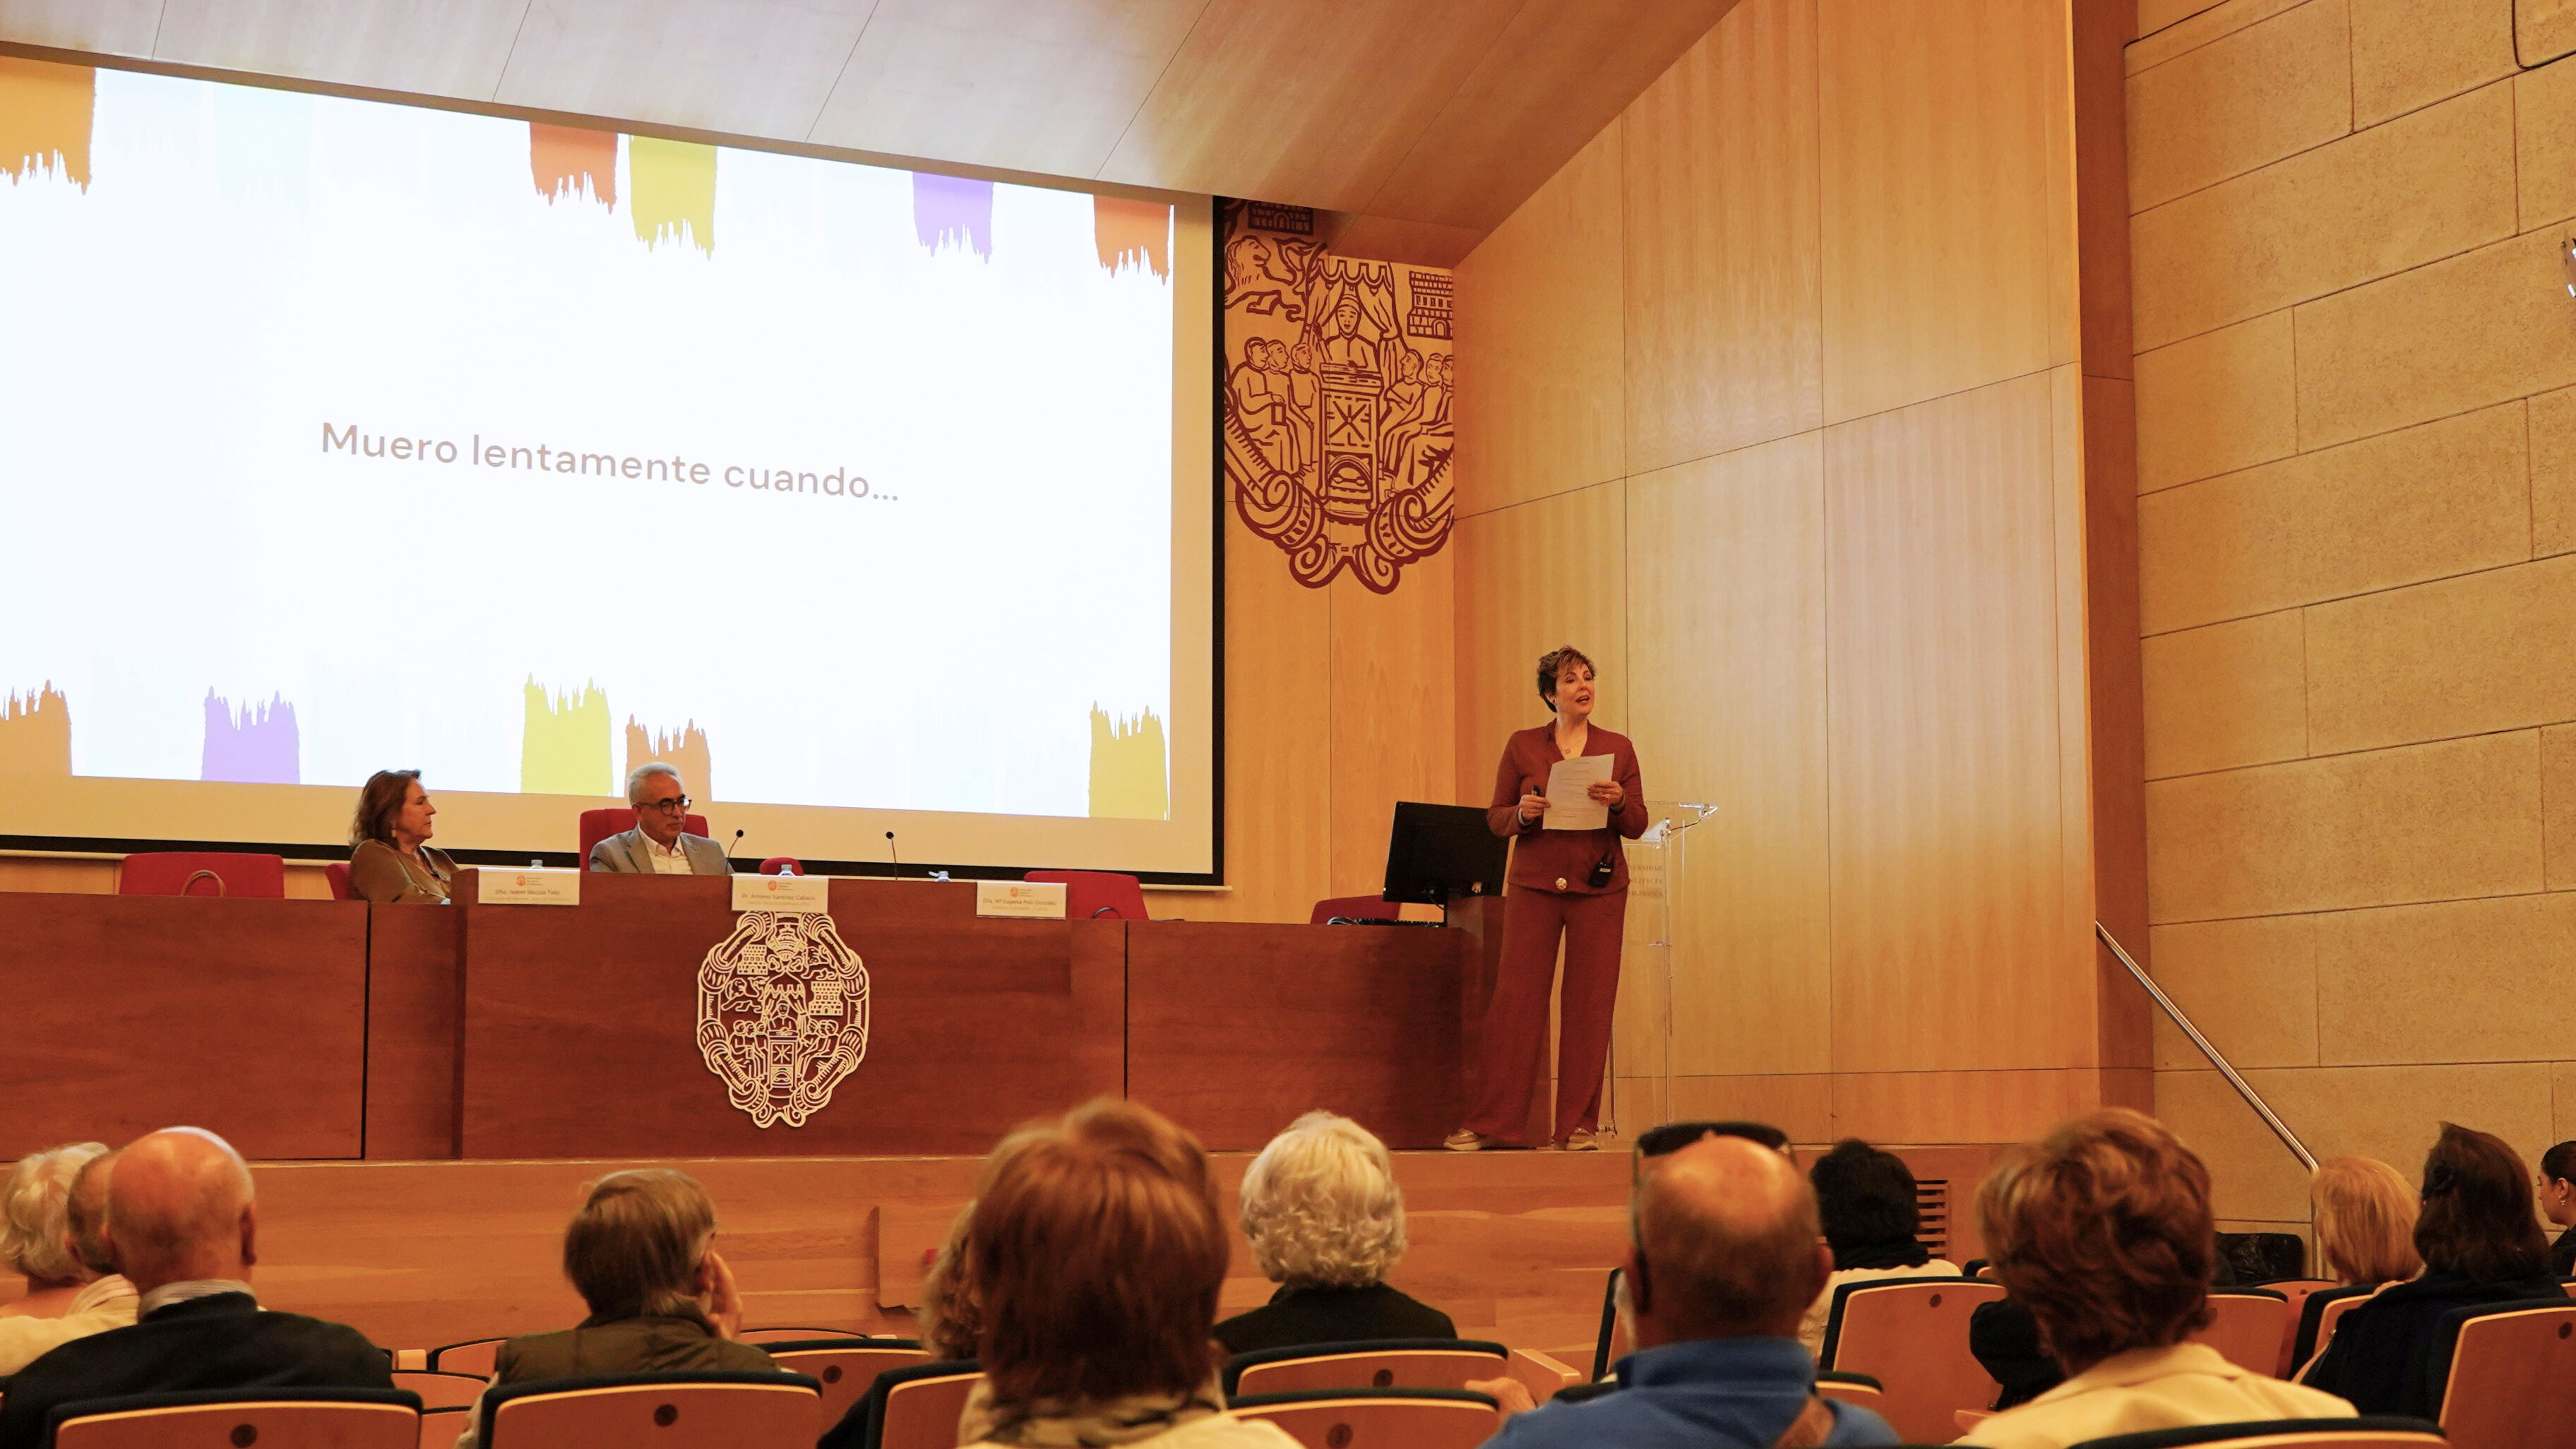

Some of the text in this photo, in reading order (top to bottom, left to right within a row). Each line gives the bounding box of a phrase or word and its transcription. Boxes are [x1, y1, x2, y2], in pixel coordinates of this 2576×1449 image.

[322, 422, 898, 501] Muero lentamente cuando...
